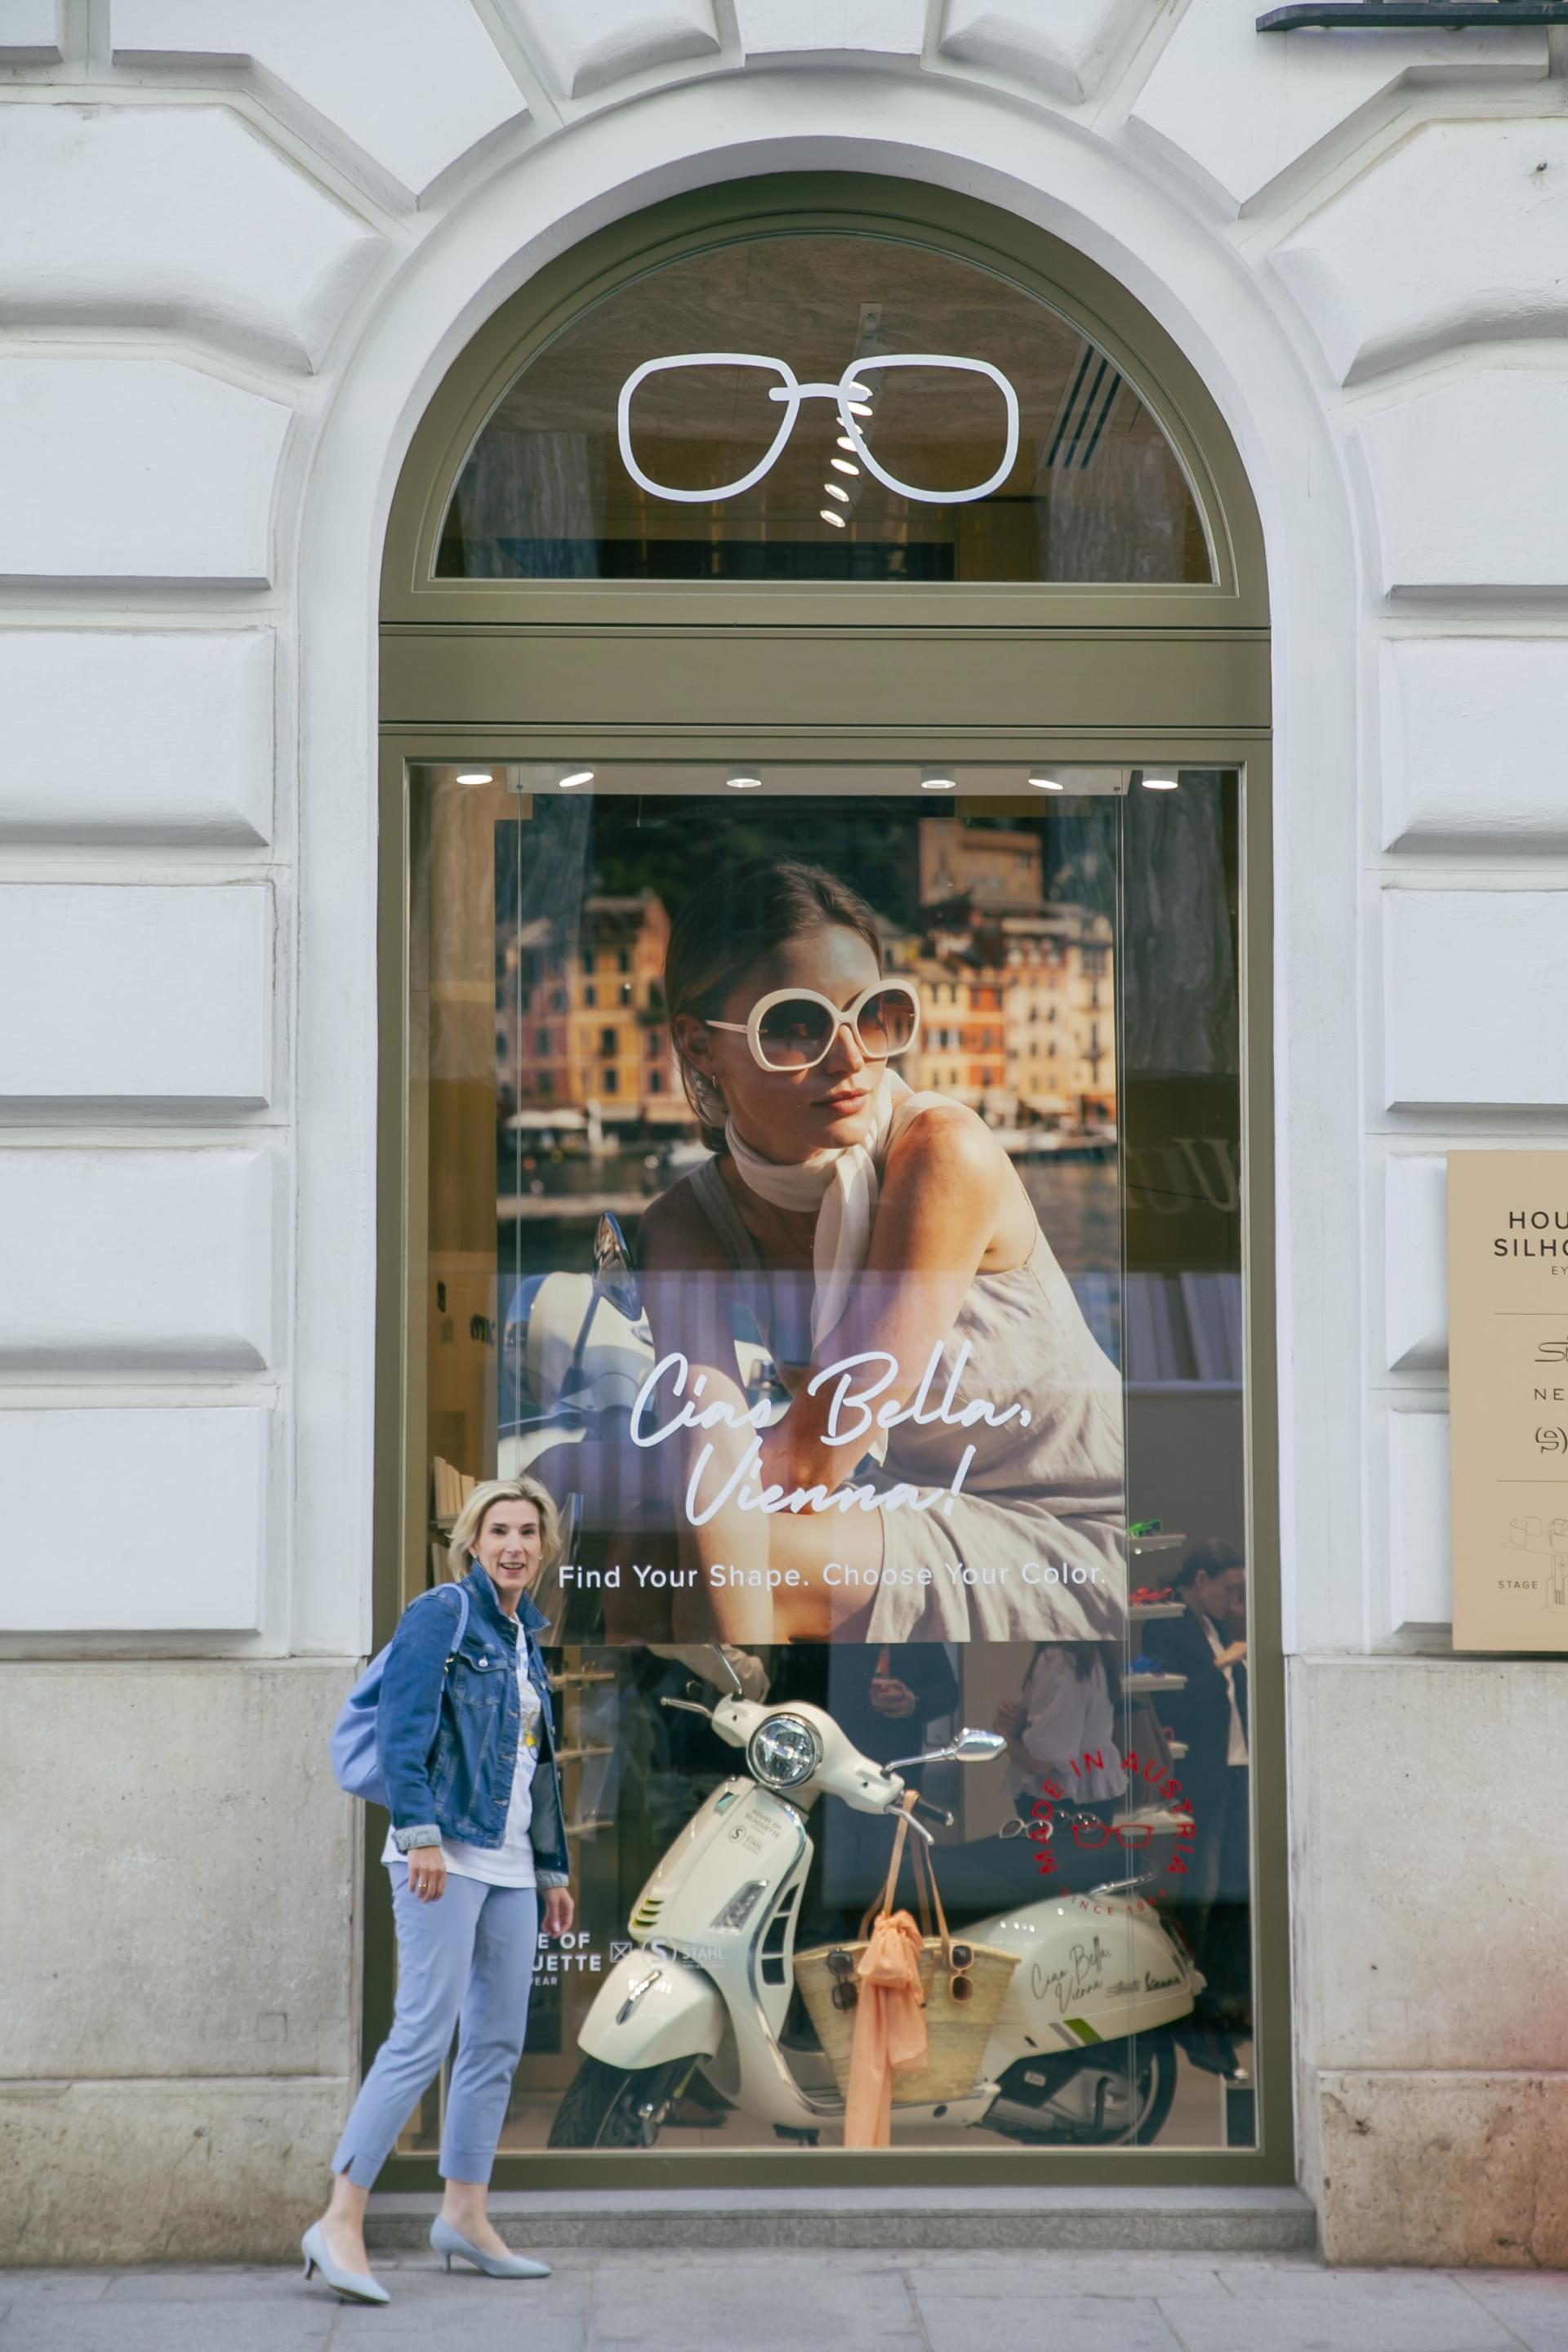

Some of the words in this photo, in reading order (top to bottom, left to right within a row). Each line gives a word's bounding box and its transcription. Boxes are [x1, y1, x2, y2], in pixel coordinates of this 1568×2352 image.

[630, 1352, 777, 1448] Ciao
[685, 1436, 977, 1526] Vienna!
[559, 1566, 621, 1588] Find
[633, 1566, 697, 1588] Your
[710, 1565, 809, 1591] Shape.
[822, 1563, 933, 1586] Choose
[945, 1562, 1009, 1585] Your
[1021, 1561, 1106, 1584] Color.
[1499, 1580, 1539, 1589] STAGE
[1032, 1777, 1065, 1875] MADE
[1071, 1750, 1104, 1778] IN
[1120, 1751, 1196, 1874] AUSTRIA
[560, 1933, 590, 1949] OF
[683, 1947, 724, 1960] STAHL
